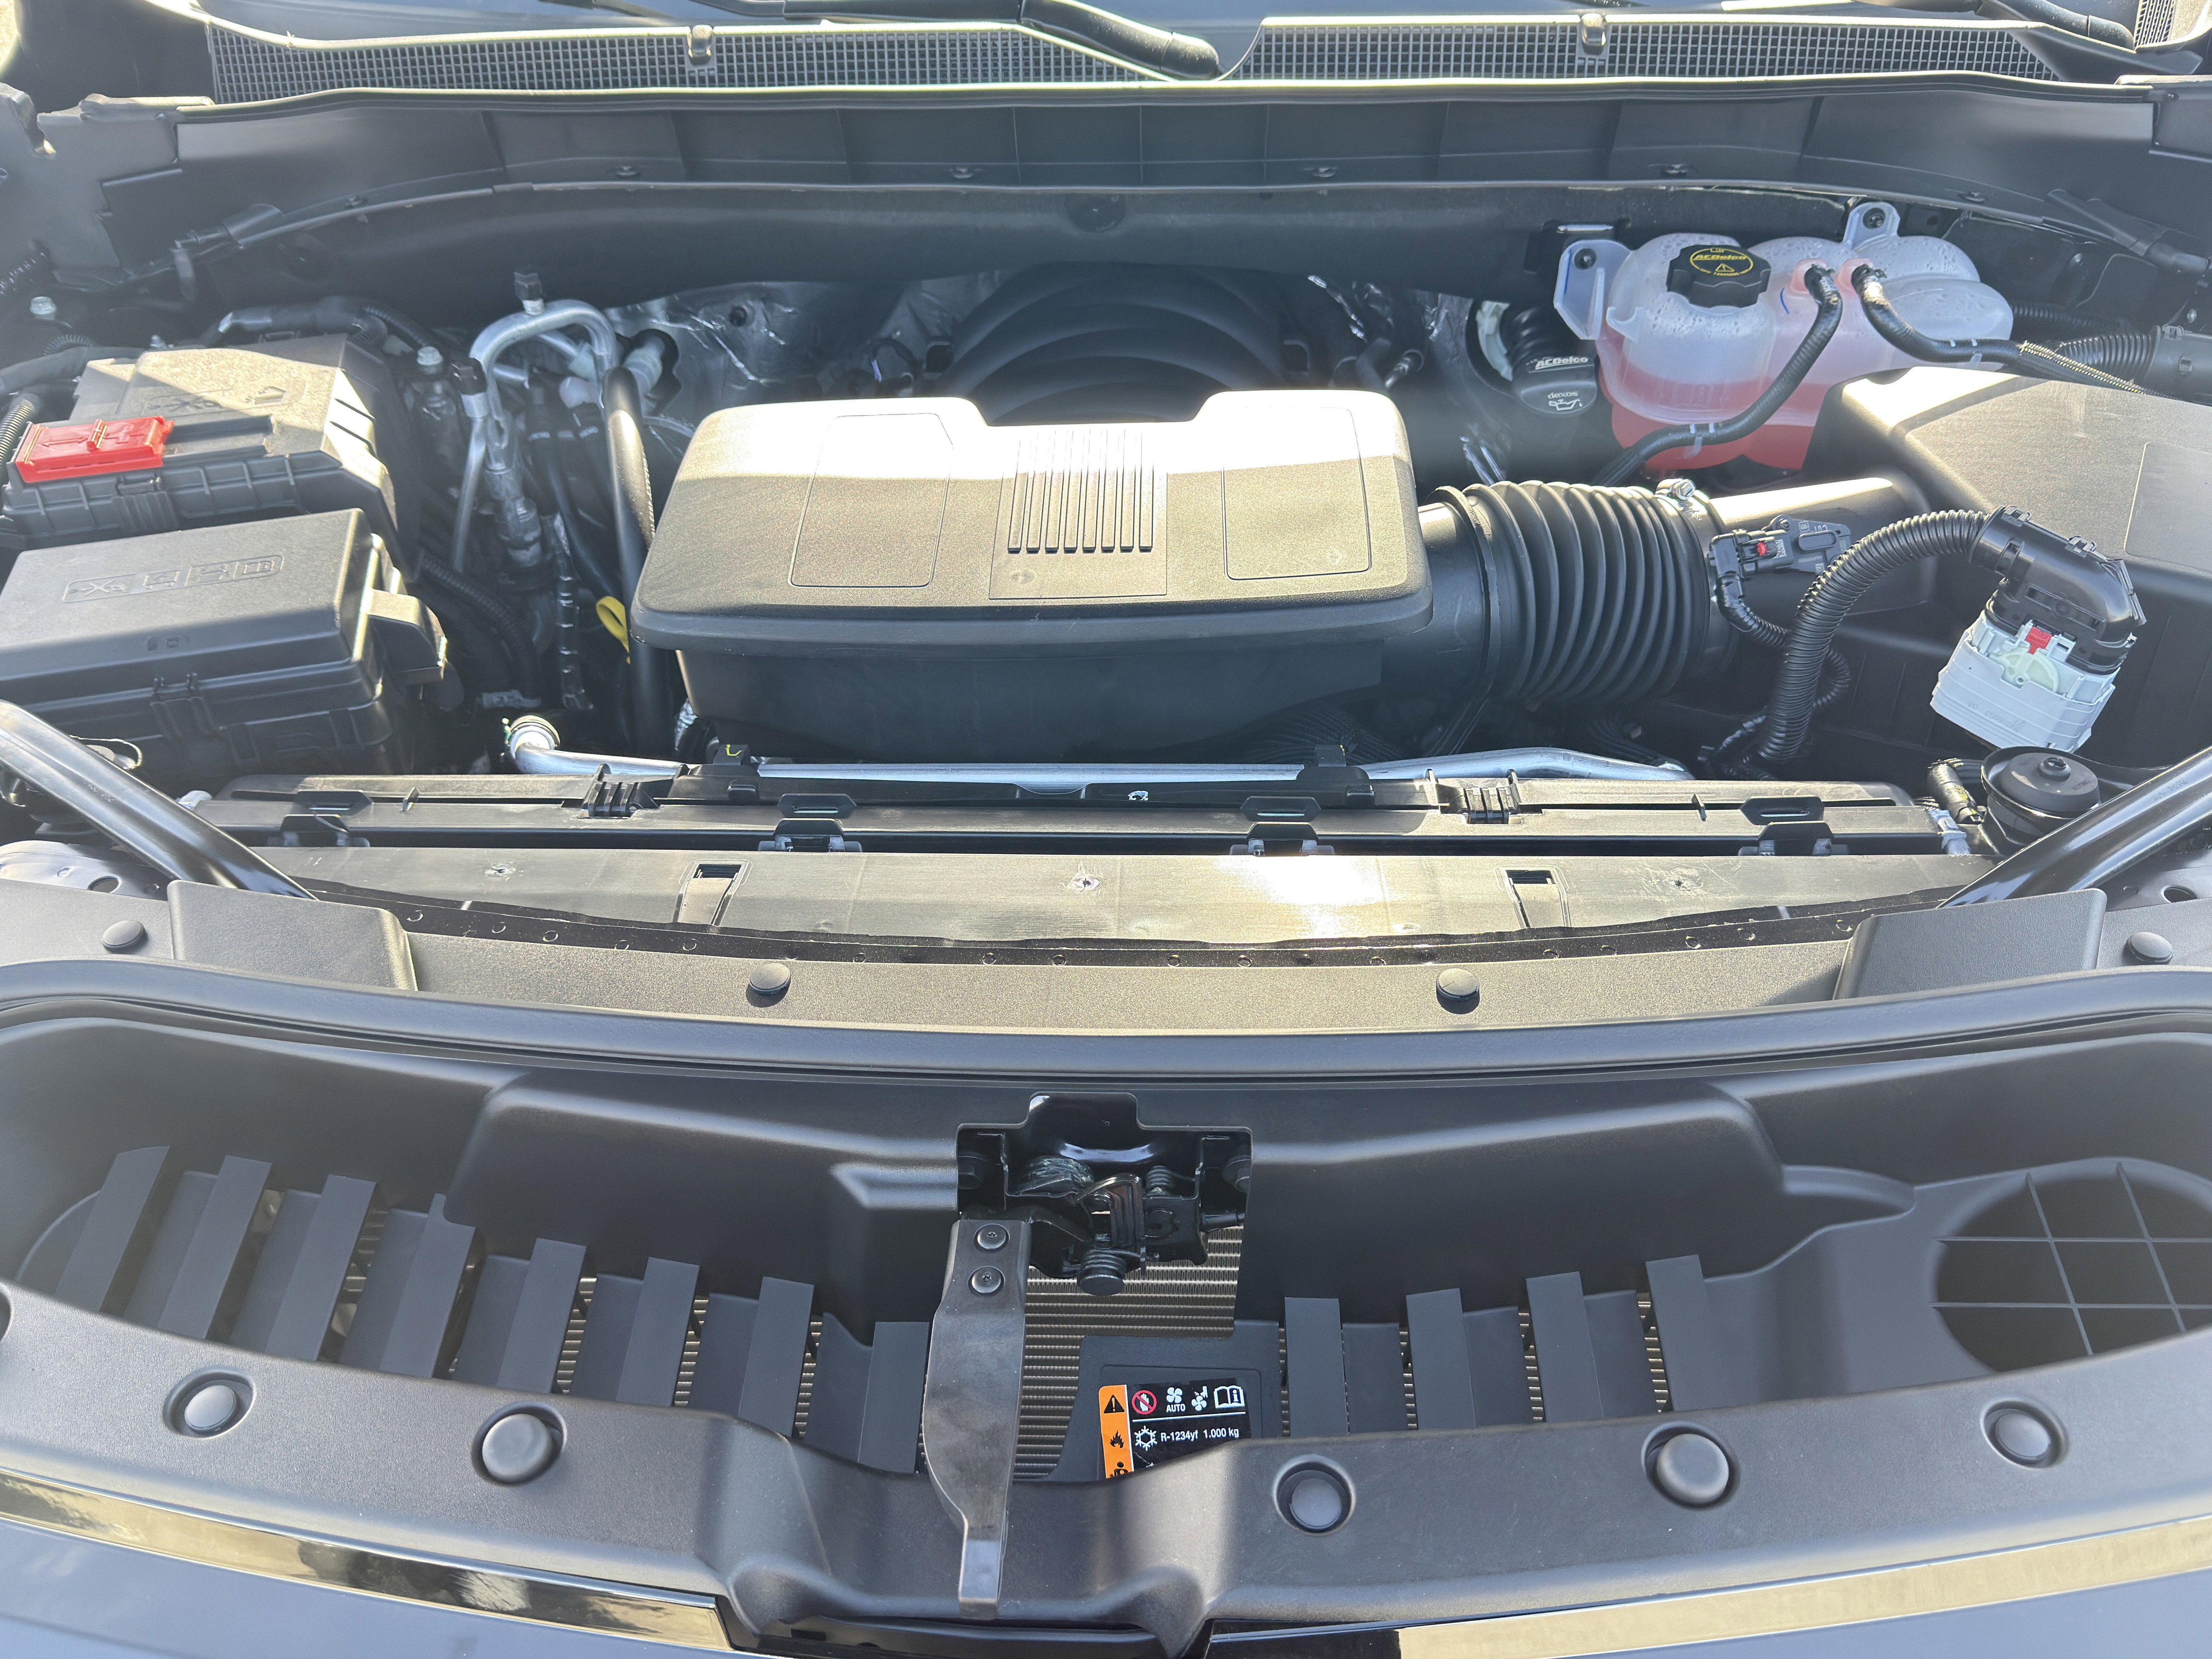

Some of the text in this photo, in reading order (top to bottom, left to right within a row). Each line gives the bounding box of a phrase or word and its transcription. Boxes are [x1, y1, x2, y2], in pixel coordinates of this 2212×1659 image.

[1535, 356, 1589, 370] ACDelco
[1547, 391, 1578, 399] dexos
[1166, 1404, 1186, 1412] AUTO
[1161, 1427, 1239, 1442] R-1234yf 1.000 kg
